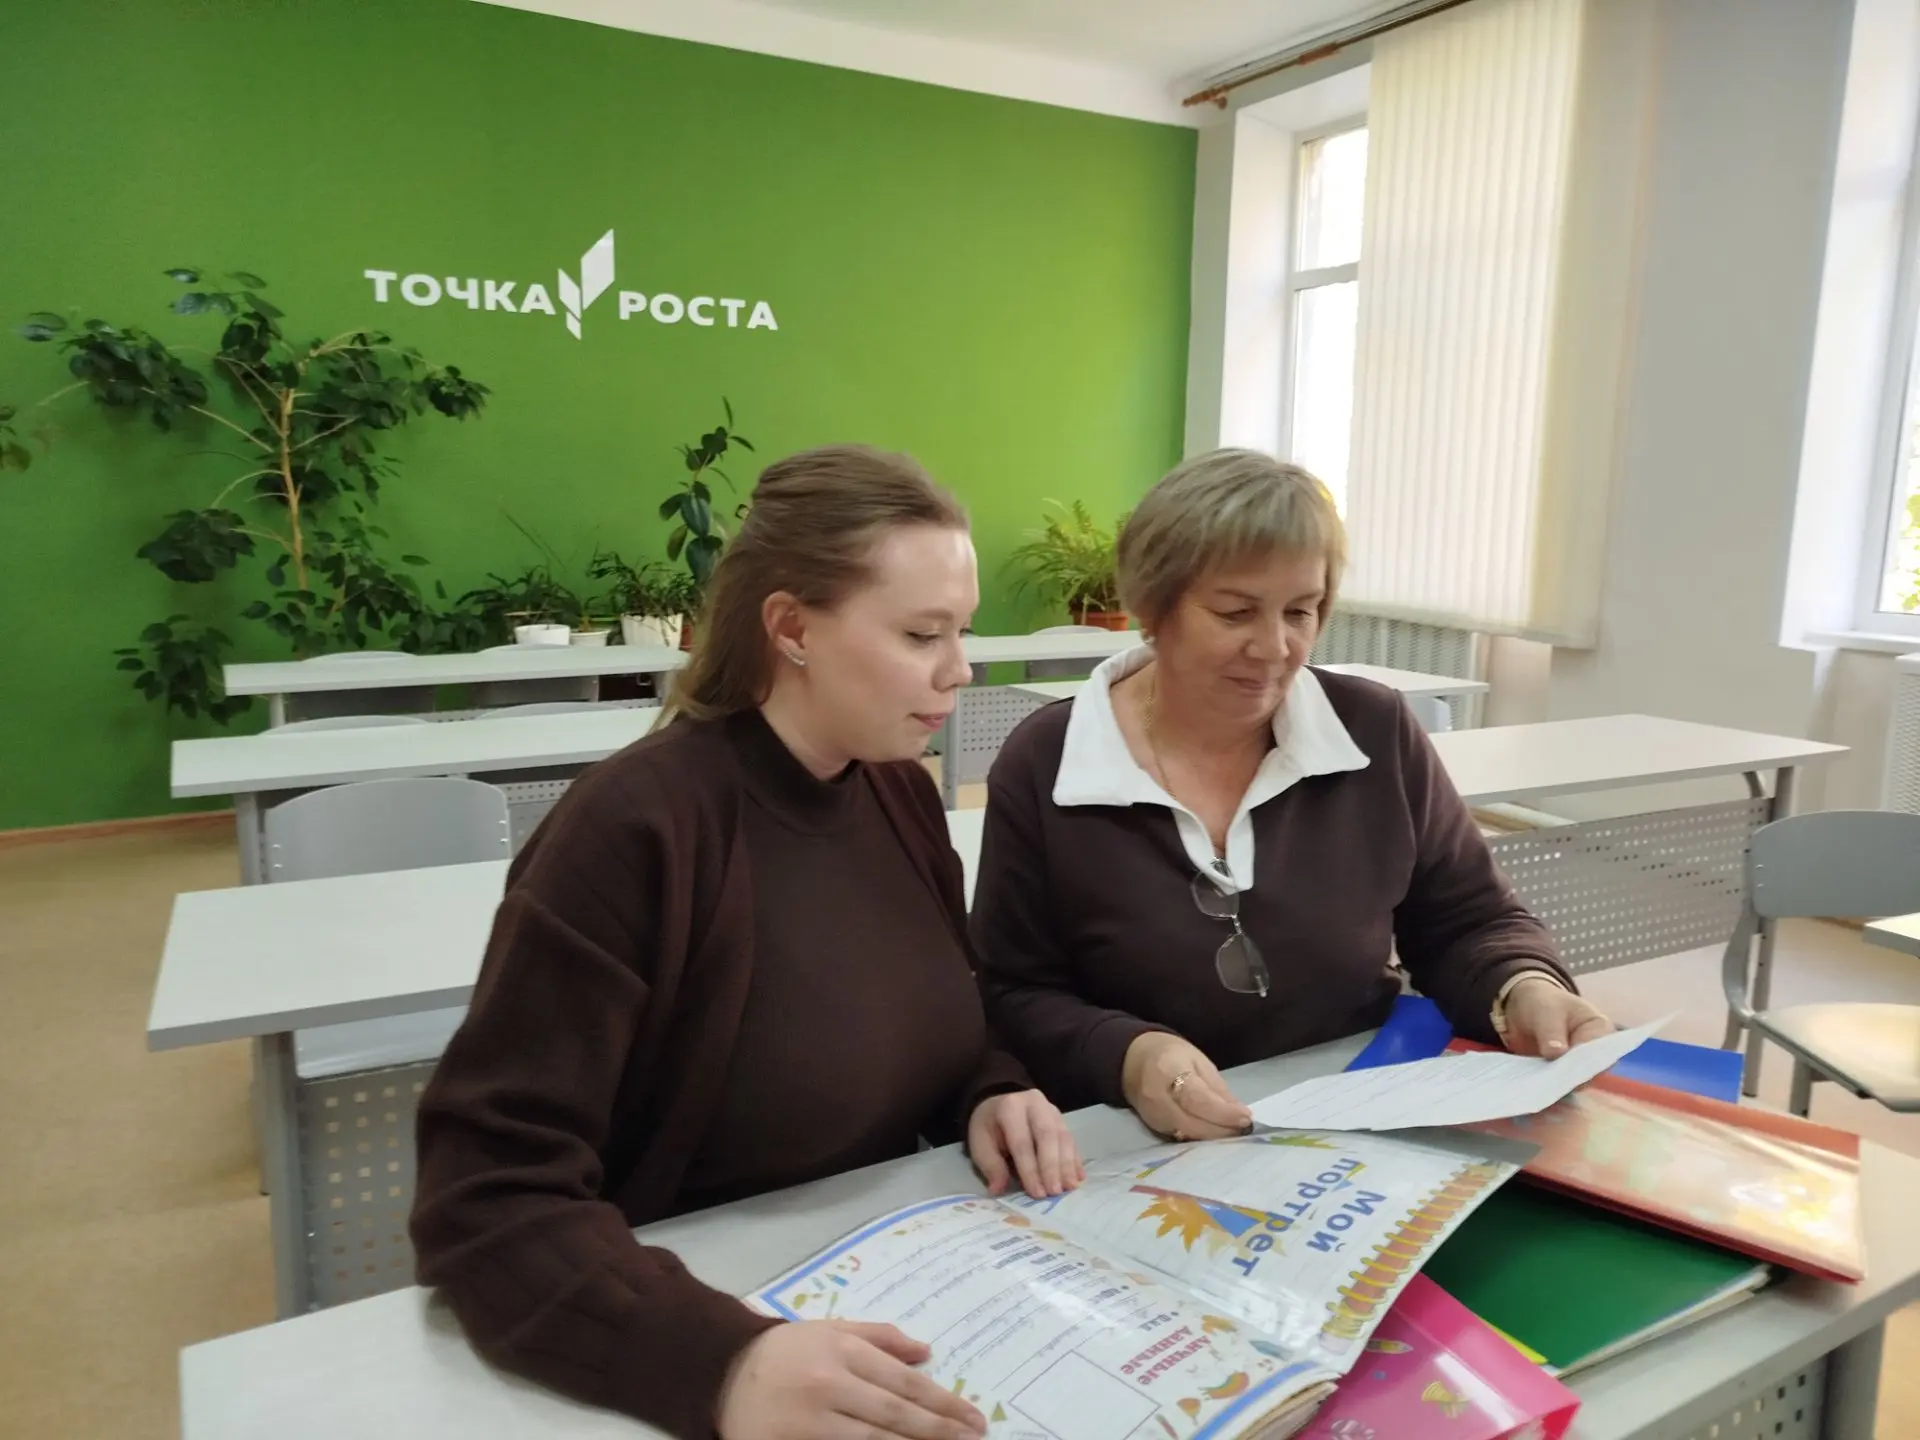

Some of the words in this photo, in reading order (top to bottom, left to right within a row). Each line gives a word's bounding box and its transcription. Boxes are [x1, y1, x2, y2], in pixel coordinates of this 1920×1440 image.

[364, 268, 556, 316] ТОЧКА
[619, 290, 779, 331] РОСТА
[1232, 1158, 1361, 1277] портрет
[1306, 1190, 1387, 1253] Мой
